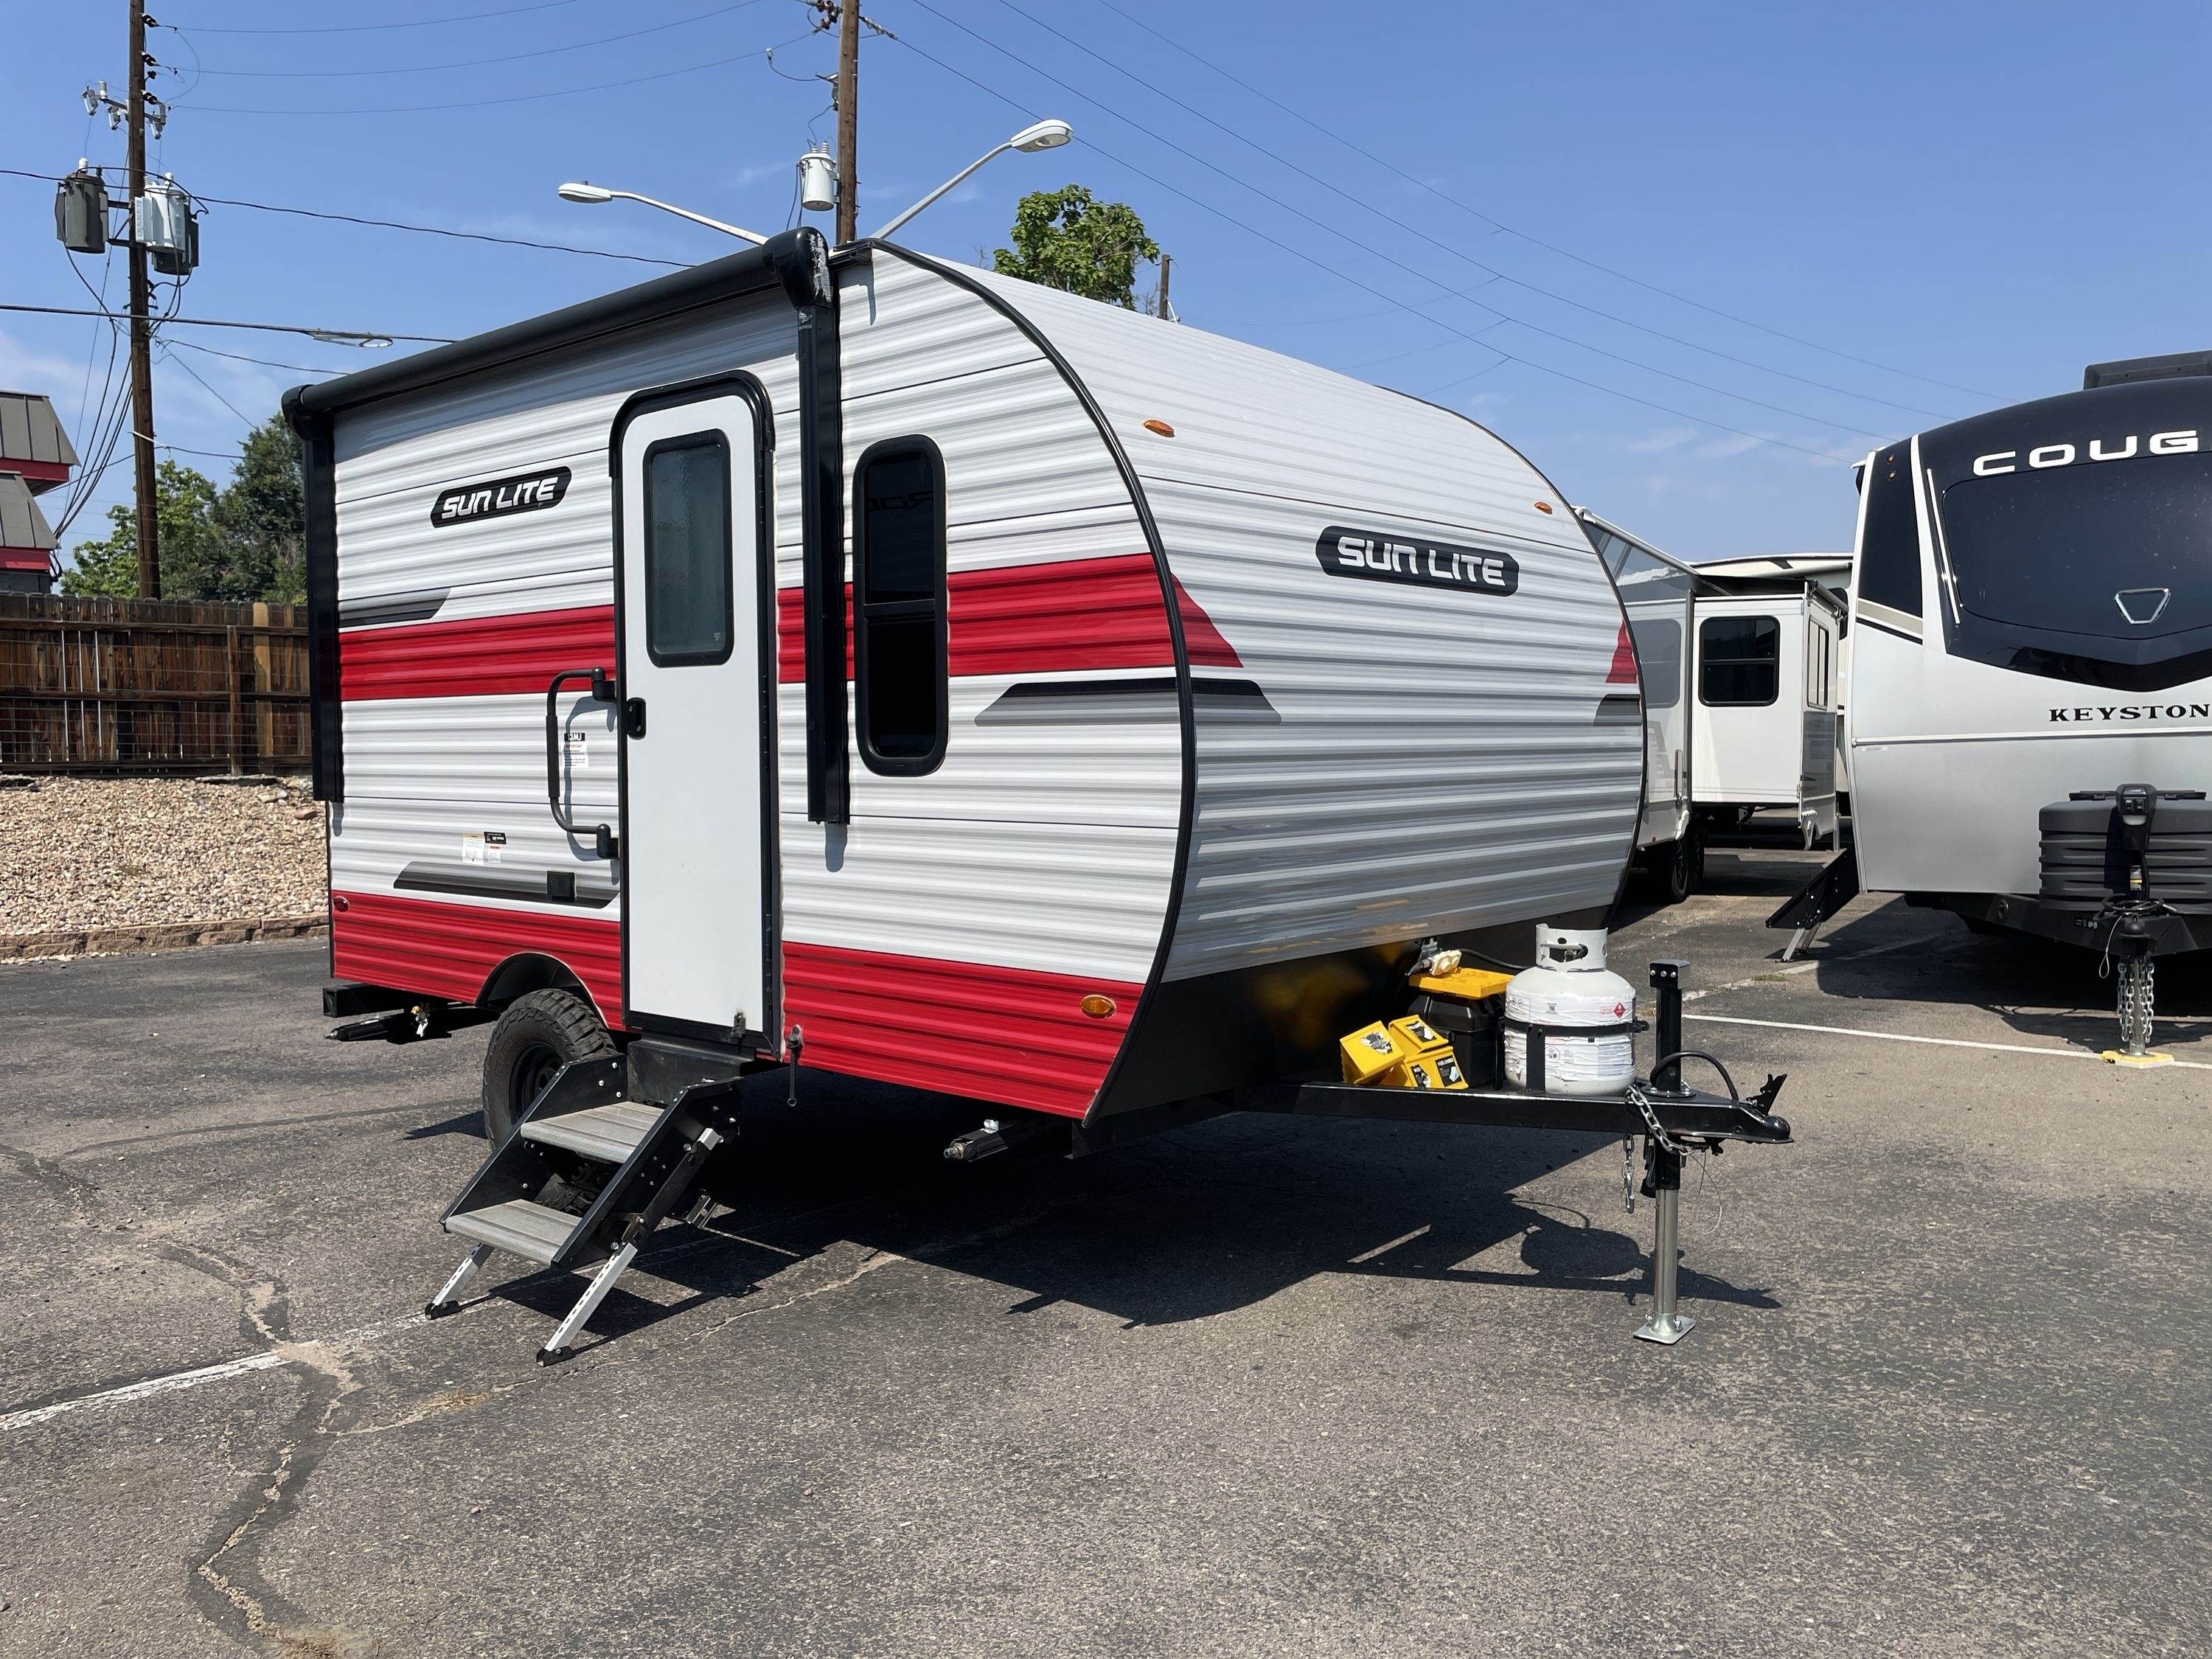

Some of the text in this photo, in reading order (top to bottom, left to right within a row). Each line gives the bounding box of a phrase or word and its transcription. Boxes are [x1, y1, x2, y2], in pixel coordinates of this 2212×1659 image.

[1973, 430, 2199, 476] COUG
[441, 476, 559, 519] SUN LITE
[1337, 536, 1506, 586] SUN LITE
[2048, 703, 2211, 722] KEYSTON
